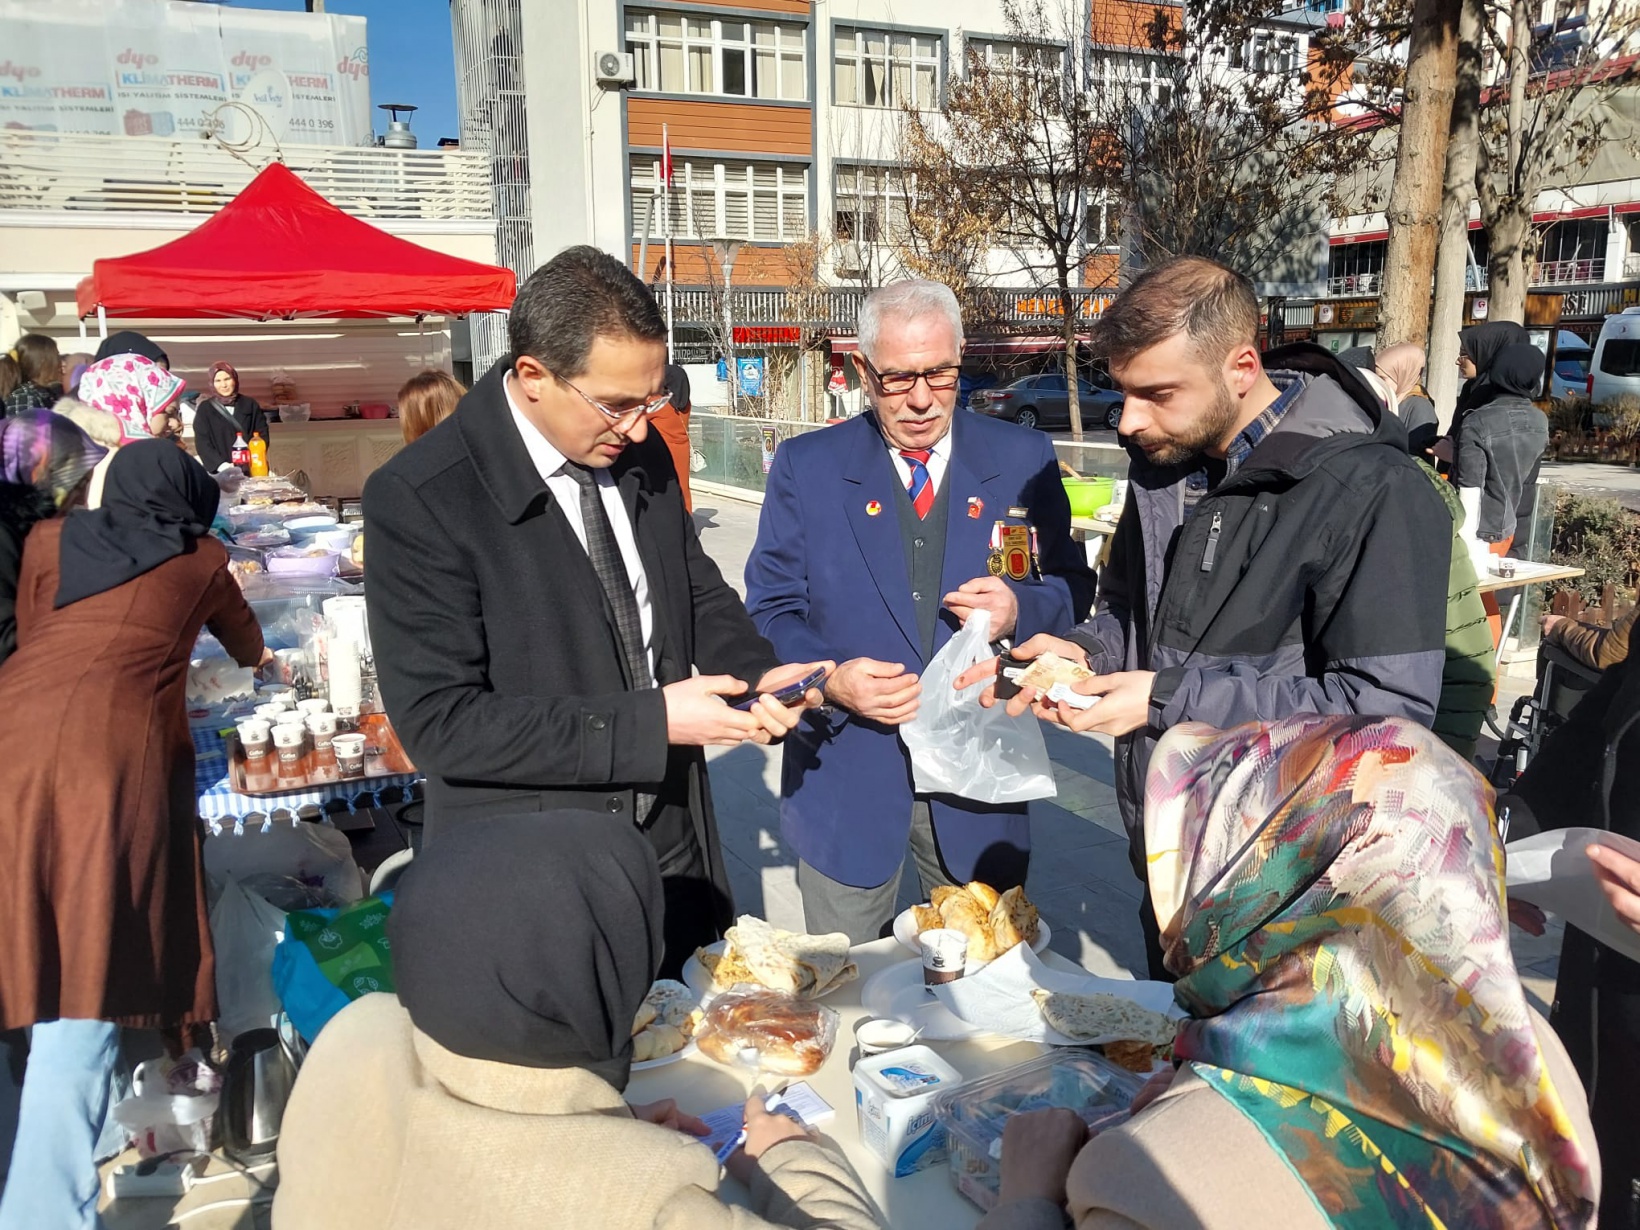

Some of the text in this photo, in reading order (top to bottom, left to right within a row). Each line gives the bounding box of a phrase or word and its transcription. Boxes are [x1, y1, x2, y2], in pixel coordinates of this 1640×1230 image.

[117, 48, 159, 69] dyo
[231, 51, 272, 71] dyo
[289, 118, 334, 129] 444 0 396
